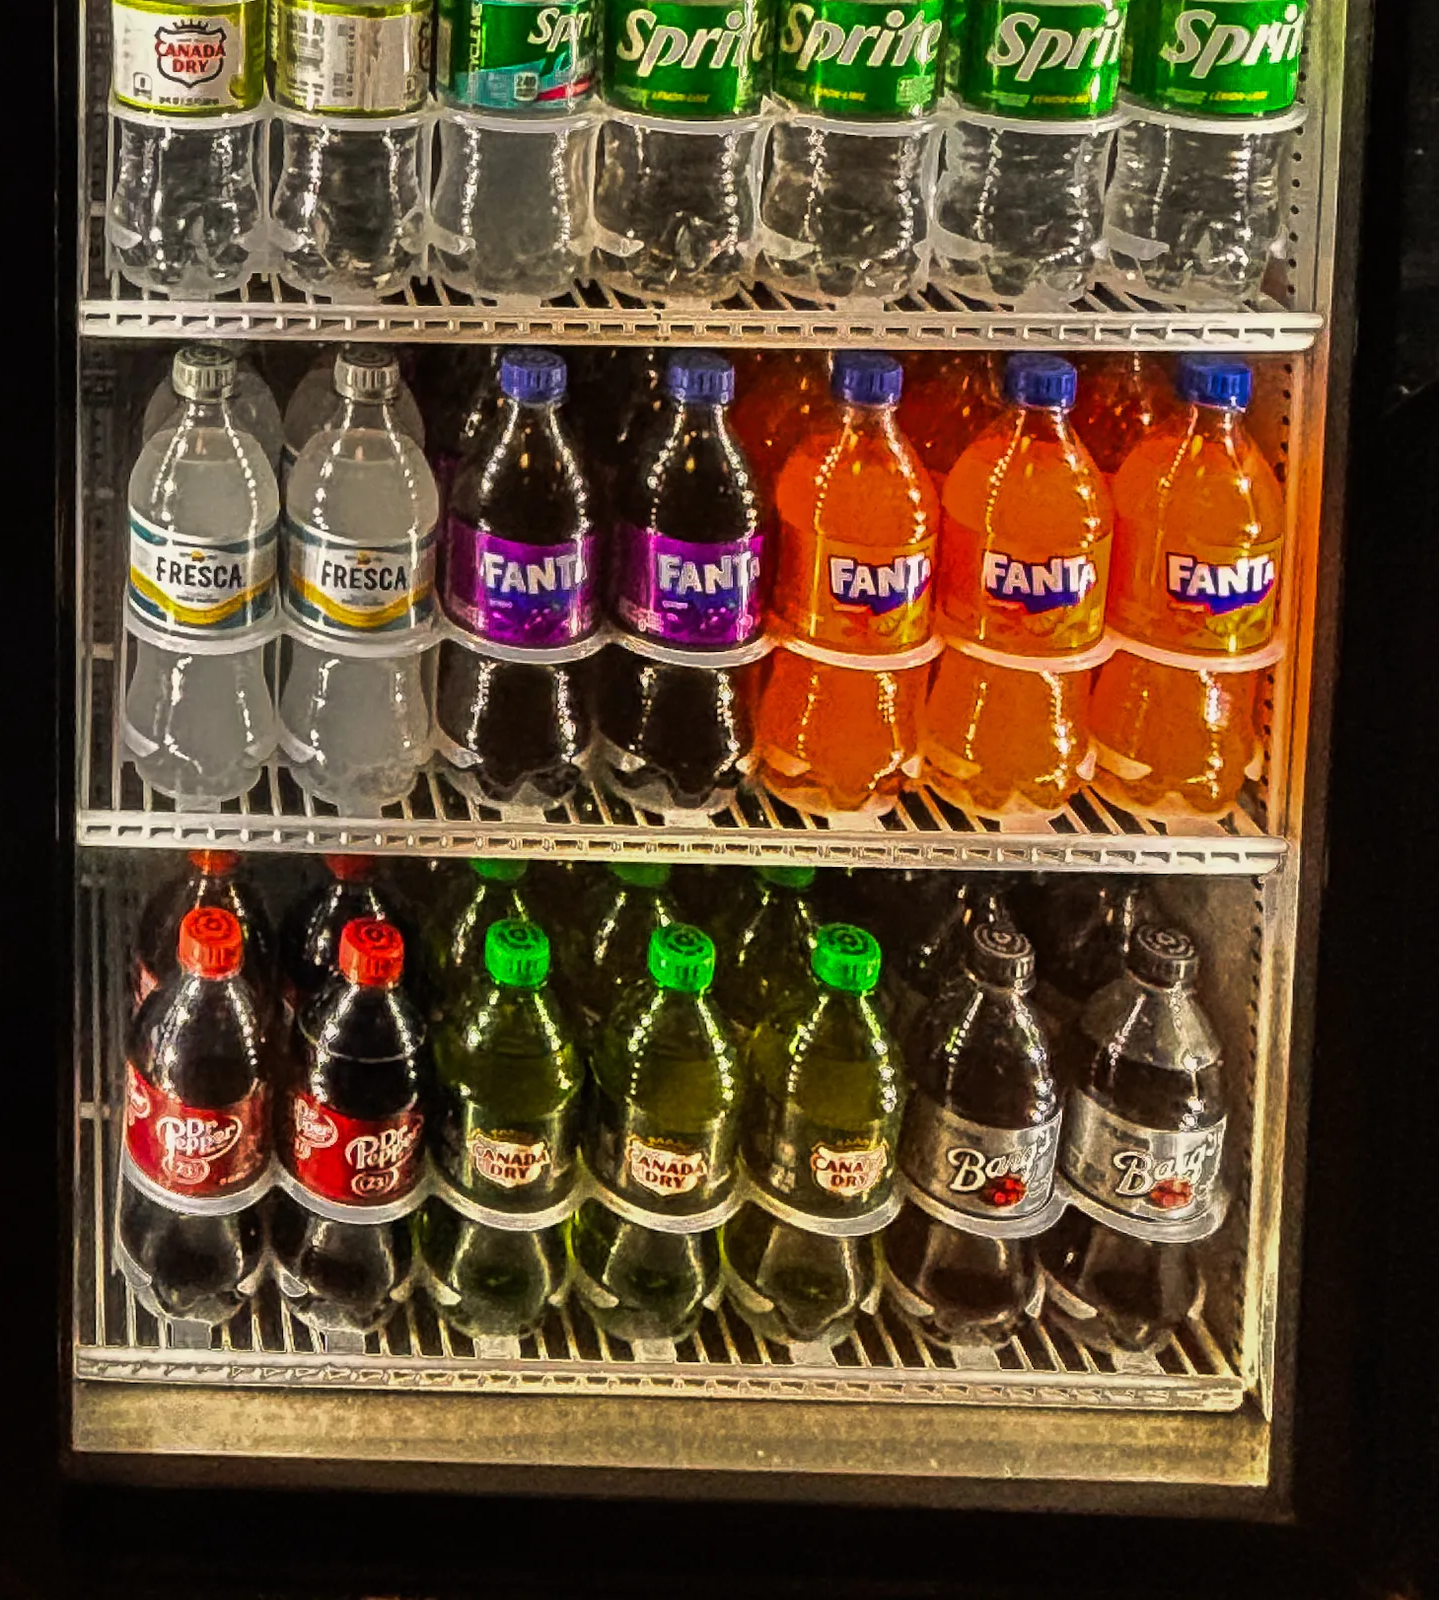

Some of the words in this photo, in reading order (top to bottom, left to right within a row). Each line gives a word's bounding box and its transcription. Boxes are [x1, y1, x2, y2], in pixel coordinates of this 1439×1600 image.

[781, 2, 943, 71] Sprite
[155, 40, 227, 58] CANADA
[172, 59, 210, 74] DRY
[156, 555, 242, 589] FRESCA
[321, 560, 408, 592] FRESCA
[186, 1118, 219, 1137] Dr
[156, 1116, 239, 1160] Pepper
[490, 1163, 531, 1180] DRY
[645, 1171, 687, 1189] DRY
